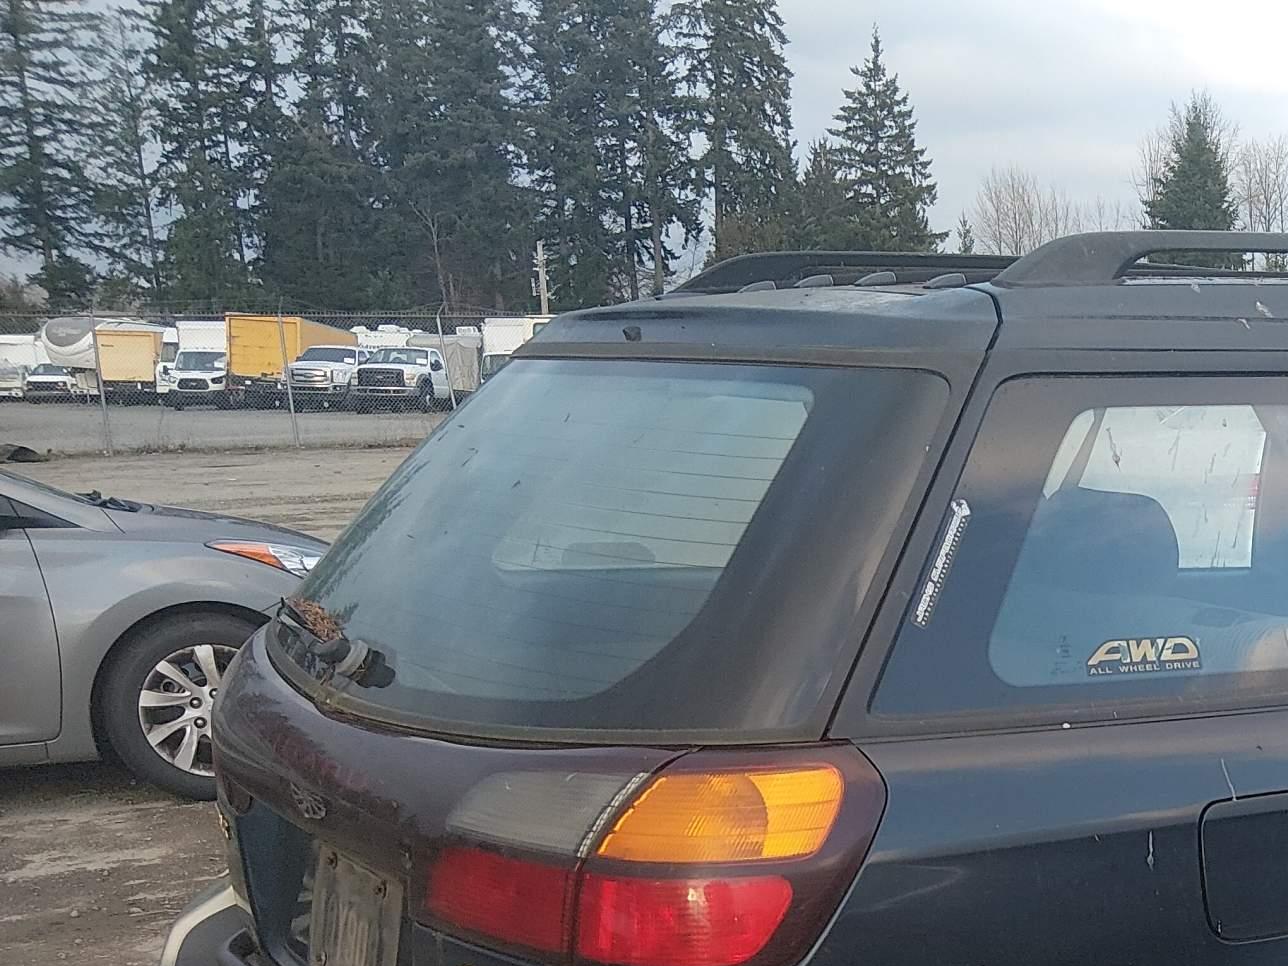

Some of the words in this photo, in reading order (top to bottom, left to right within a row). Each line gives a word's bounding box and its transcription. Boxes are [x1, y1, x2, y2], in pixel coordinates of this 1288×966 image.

[1088, 637, 1199, 666] AWD
[1089, 666, 1112, 675] ALL
[1119, 663, 1160, 673] WHEEL
[1166, 661, 1200, 670] DRIVE
